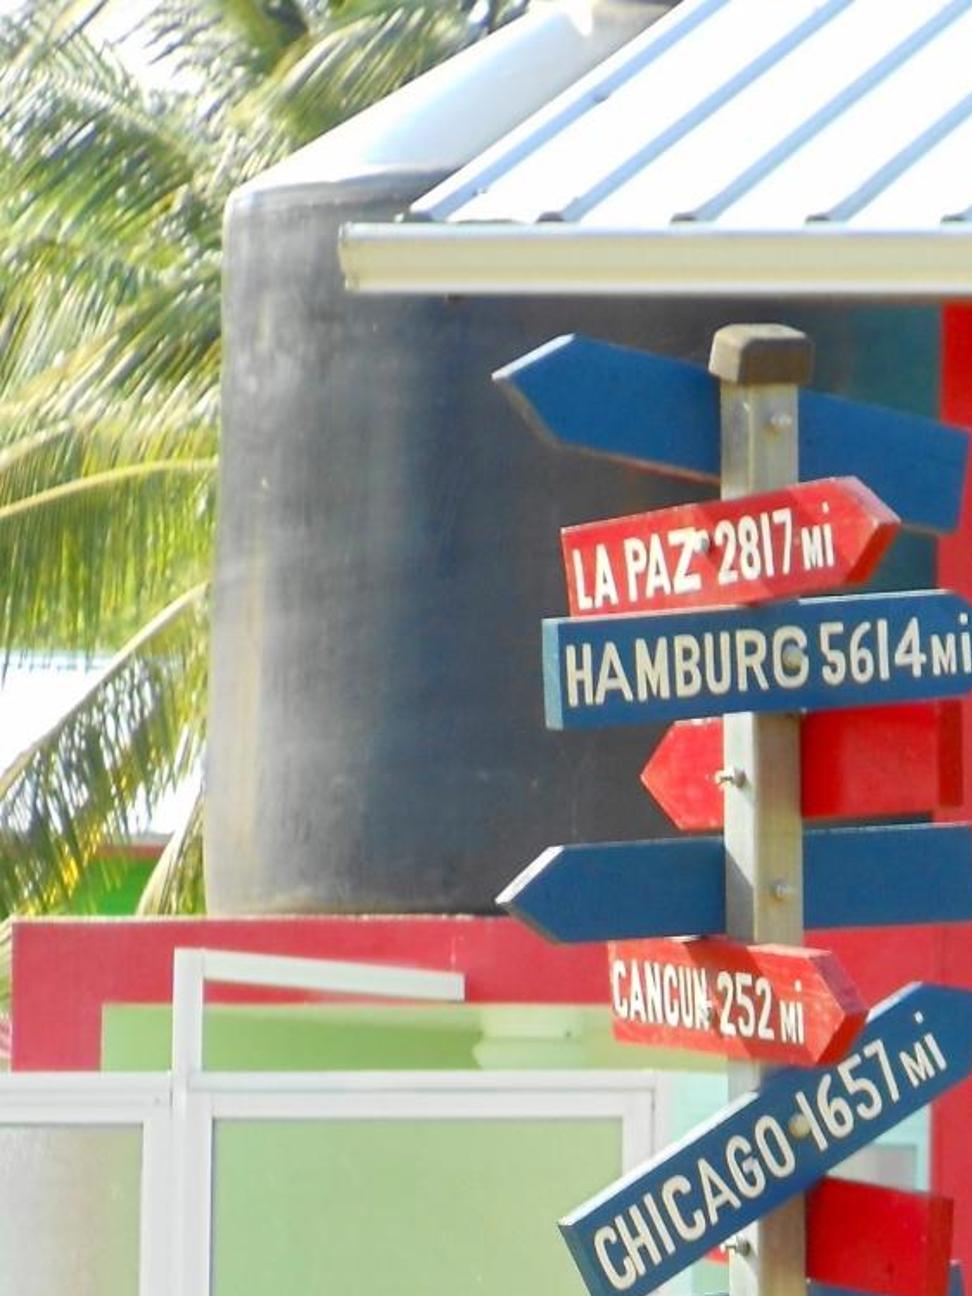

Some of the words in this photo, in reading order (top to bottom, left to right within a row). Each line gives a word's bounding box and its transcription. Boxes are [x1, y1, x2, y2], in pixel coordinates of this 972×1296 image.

[572, 548, 618, 610] LA
[624, 527, 702, 601] PAZ
[714, 508, 793, 585] 2817
[565, 625, 810, 708] HAMBURG
[820, 616, 927, 686] 5614
[613, 960, 708, 1029] CANCUN
[717, 971, 774, 1040] 252
[593, 1115, 796, 1292] CHICAGO
[796, 1039, 900, 1152] 1657
